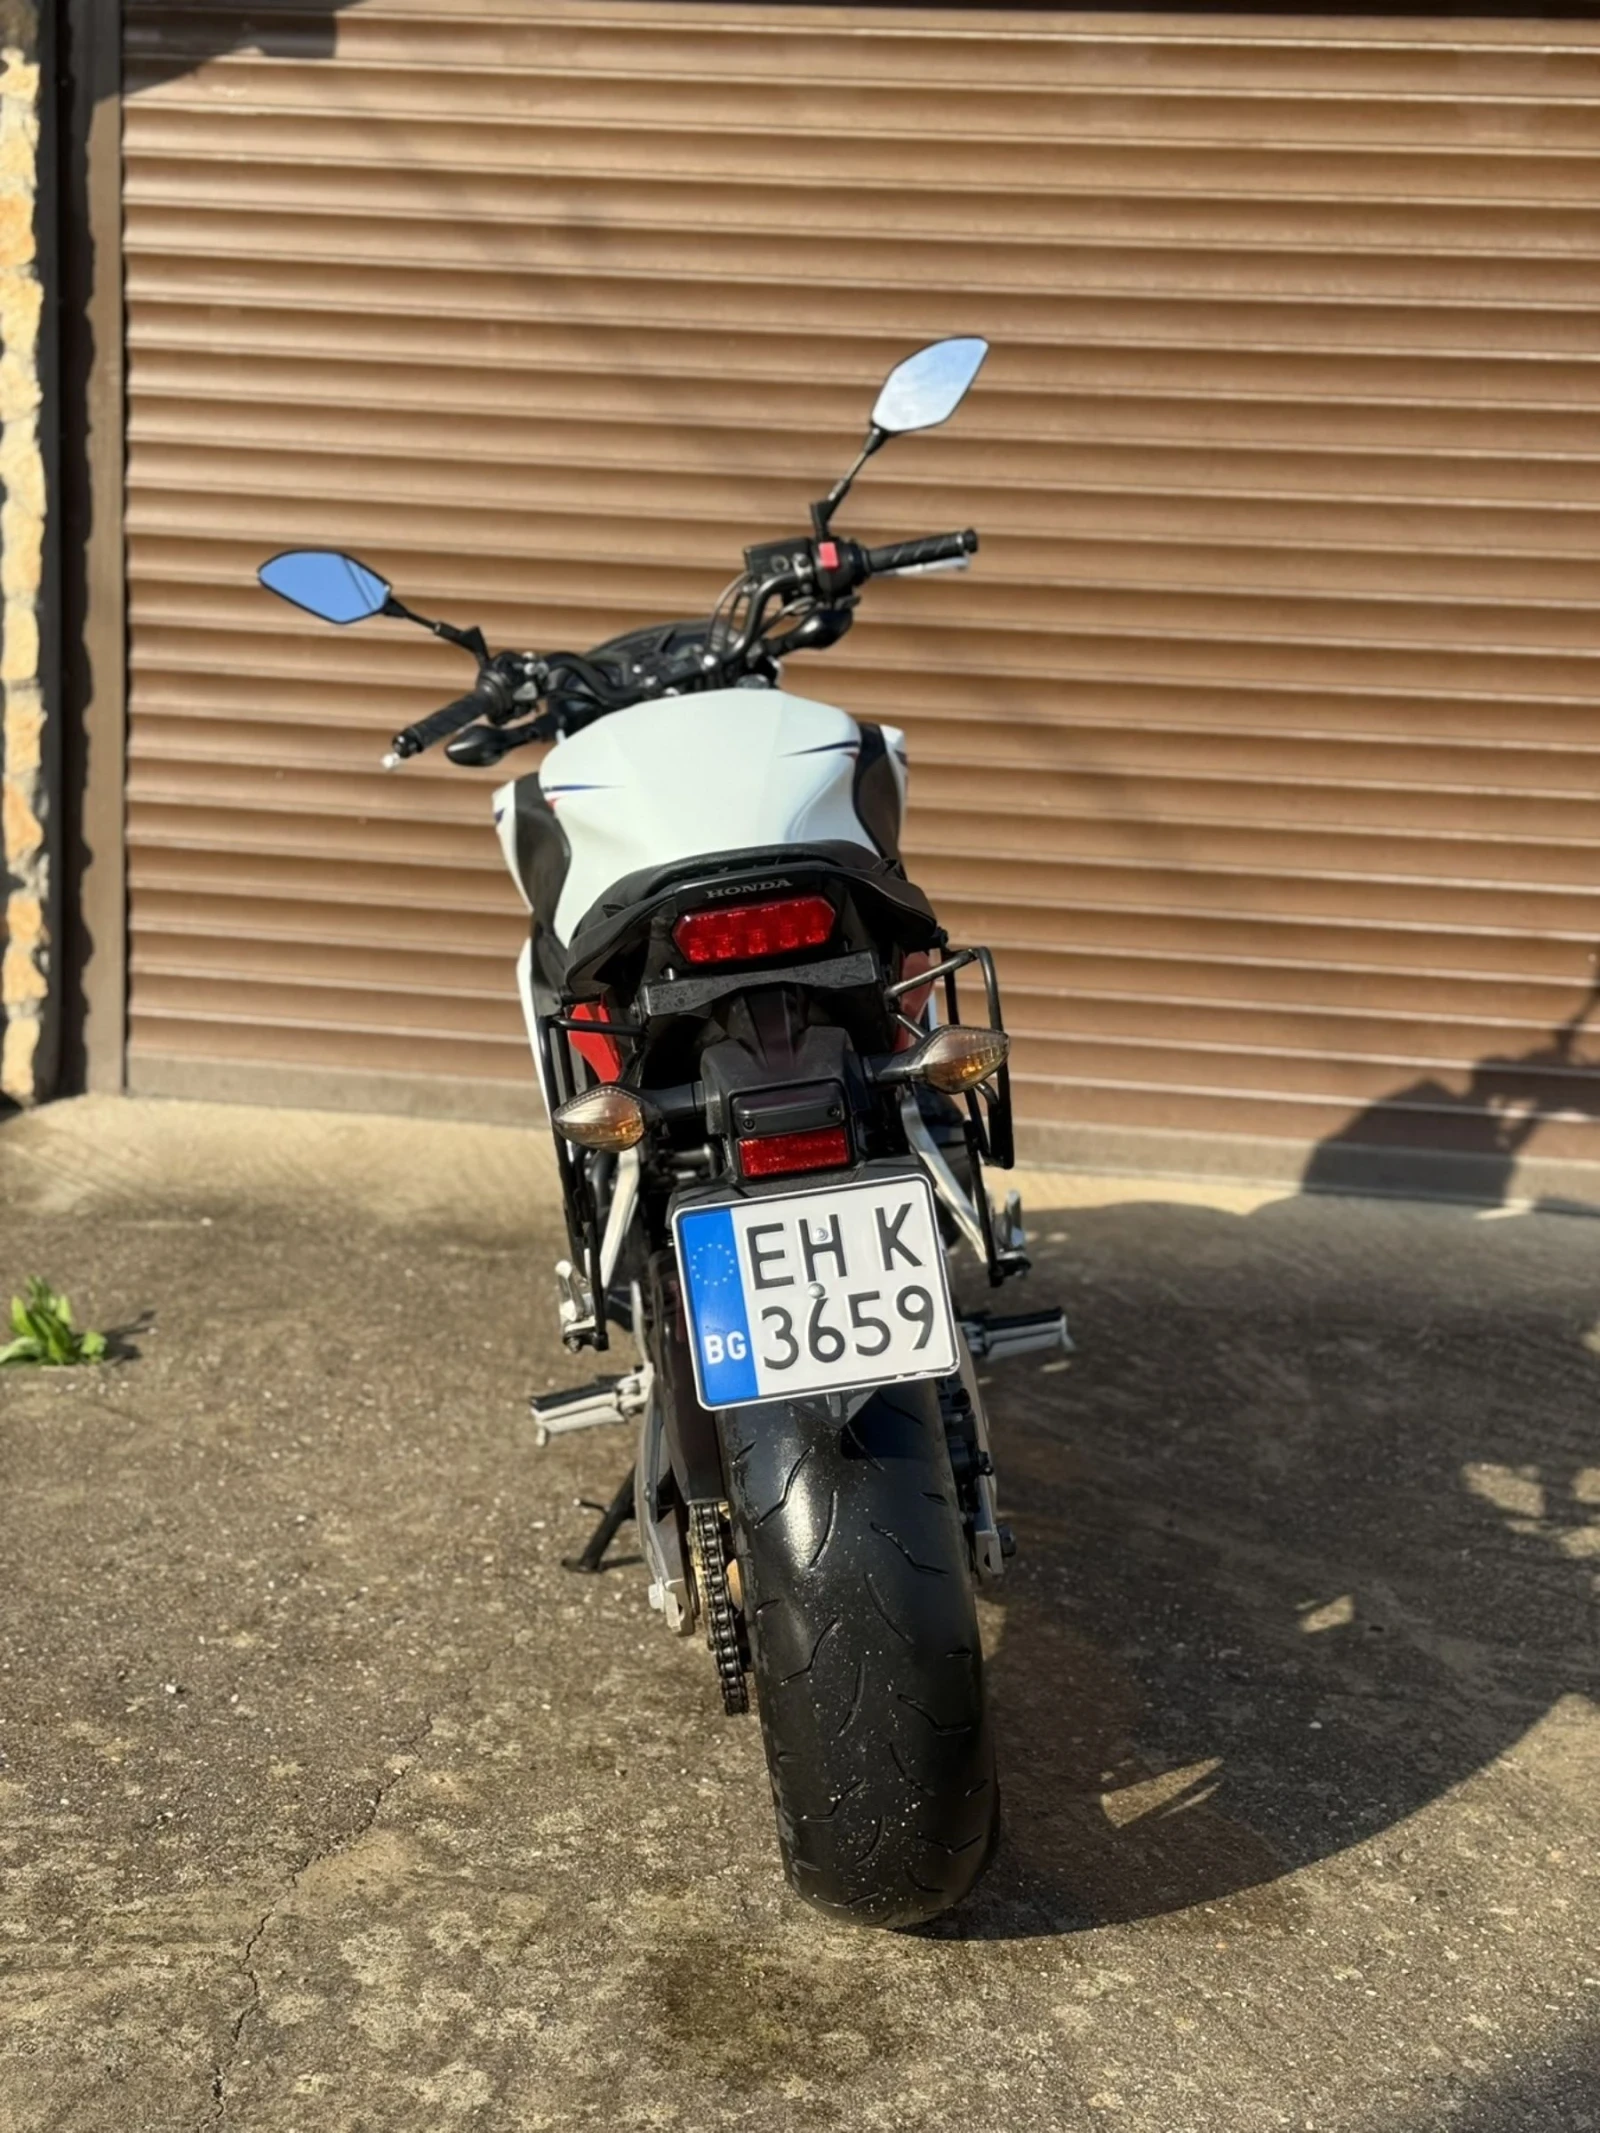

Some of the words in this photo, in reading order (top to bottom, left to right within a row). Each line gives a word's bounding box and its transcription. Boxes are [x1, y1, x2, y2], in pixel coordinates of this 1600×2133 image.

[706, 878, 793, 899] HONDA
[746, 1213, 848, 1291] EH
[874, 1202, 923, 1271] K
[703, 1330, 747, 1365] BG
[760, 1285, 935, 1370] 3659
